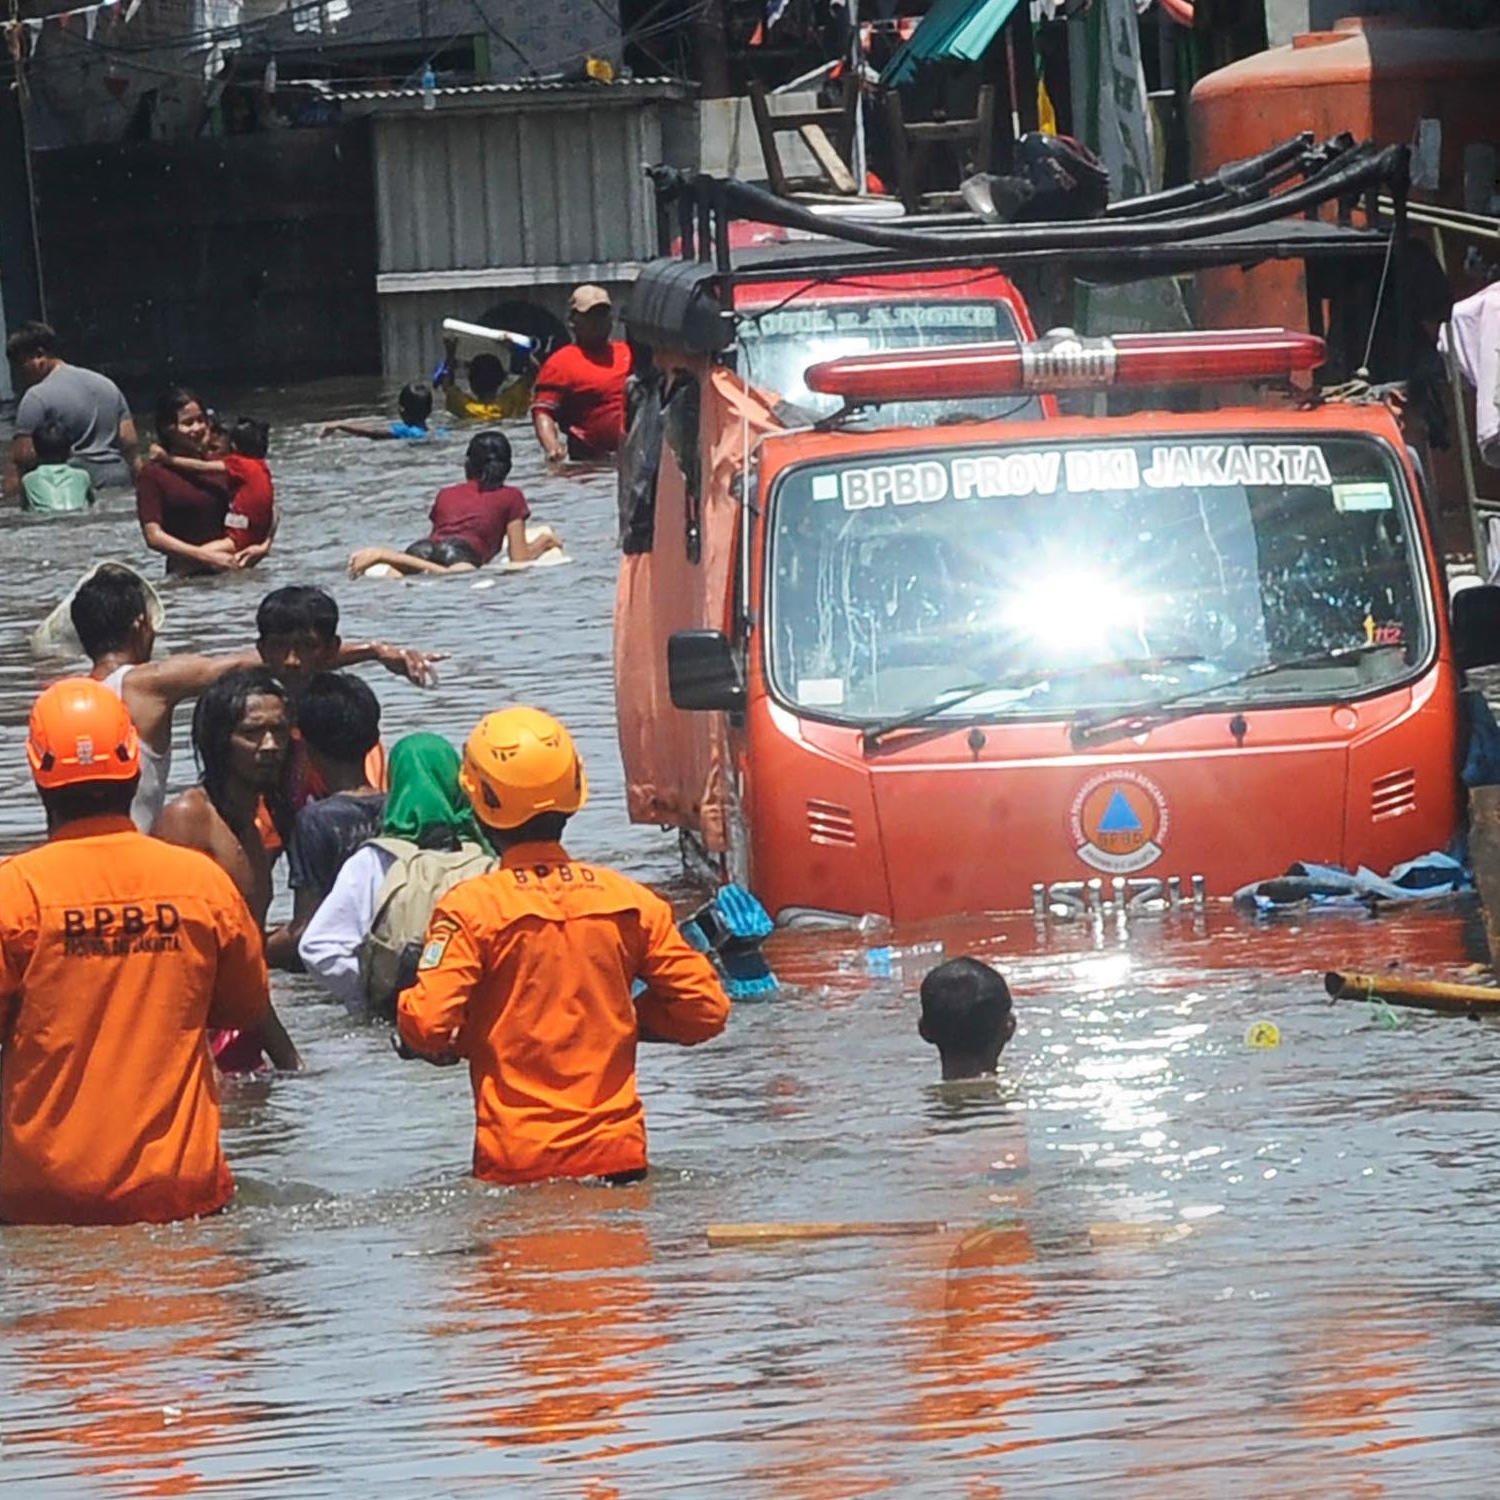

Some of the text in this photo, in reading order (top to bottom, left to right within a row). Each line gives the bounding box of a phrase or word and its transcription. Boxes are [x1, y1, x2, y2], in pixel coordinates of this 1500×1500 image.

[841, 445, 1332, 511] BPBD PROV DKI JAKARTA
[513, 864, 596, 884] BPBD
[1032, 875, 1204, 918] ISUZU
[64, 903, 180, 937] BPBD
